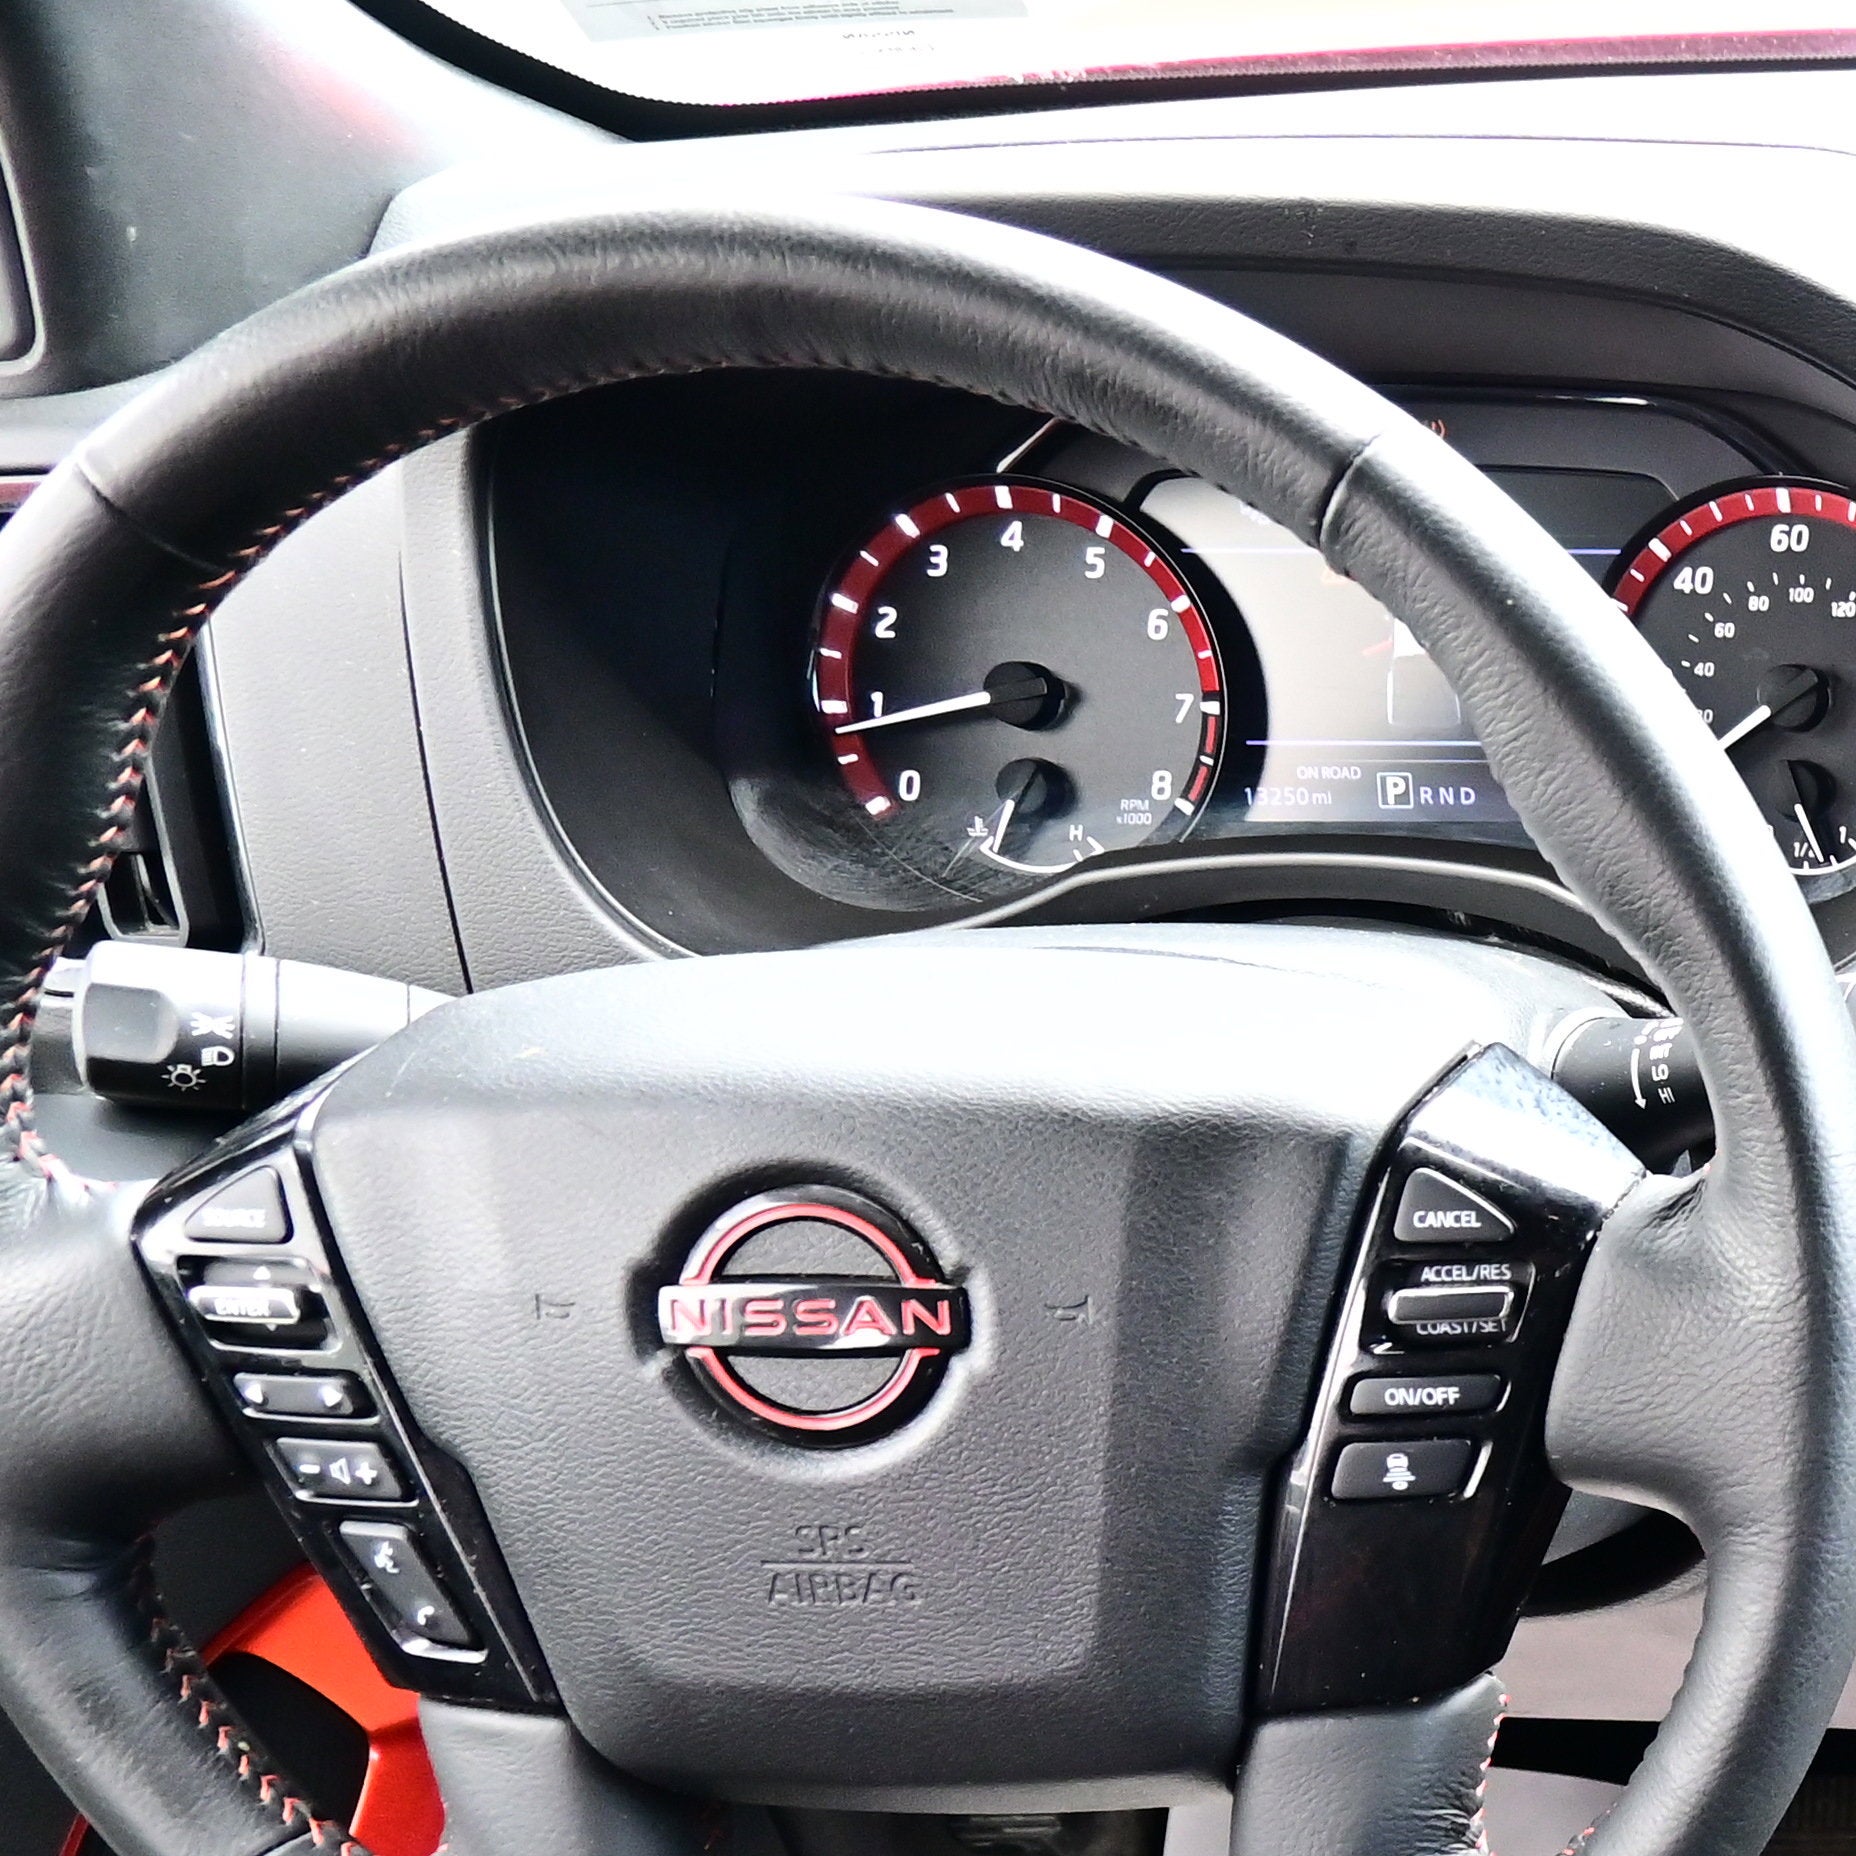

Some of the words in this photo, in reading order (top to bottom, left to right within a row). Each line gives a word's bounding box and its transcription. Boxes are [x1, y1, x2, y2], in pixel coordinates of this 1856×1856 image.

[1000, 521, 1023, 551] 4
[1770, 524, 1809, 552] 60
[927, 545, 948, 577] 3
[1085, 547, 1105, 579] 5
[1673, 567, 1713, 595] 40
[1748, 595, 1769, 611] 80
[1788, 587, 1814, 603] 100
[1831, 602, 1856, 618] 120
[875, 607, 897, 638] 2
[1147, 609, 1169, 640] 6
[1714, 622, 1735, 638] 60
[1694, 662, 1715, 677] 40
[871, 692, 884, 717] 1
[1175, 694, 1194, 723] 7
[1297, 767, 1320, 779] ON
[1322, 767, 1361, 779] ROAD
[899, 770, 921, 801] 0
[1151, 770, 1172, 800] 8
[1420, 786, 1433, 804] R
[1439, 786, 1454, 805] N
[1461, 786, 1476, 805] D
[1120, 799, 1149, 811] RPM
[1069, 824, 1083, 840] H
[1413, 1211, 1481, 1228] CANCEL
[1421, 1265, 1512, 1281] ACCEL/RES
[666, 1296, 952, 1337] NISSAN
[1385, 1387, 1460, 1405] ON/OFF
